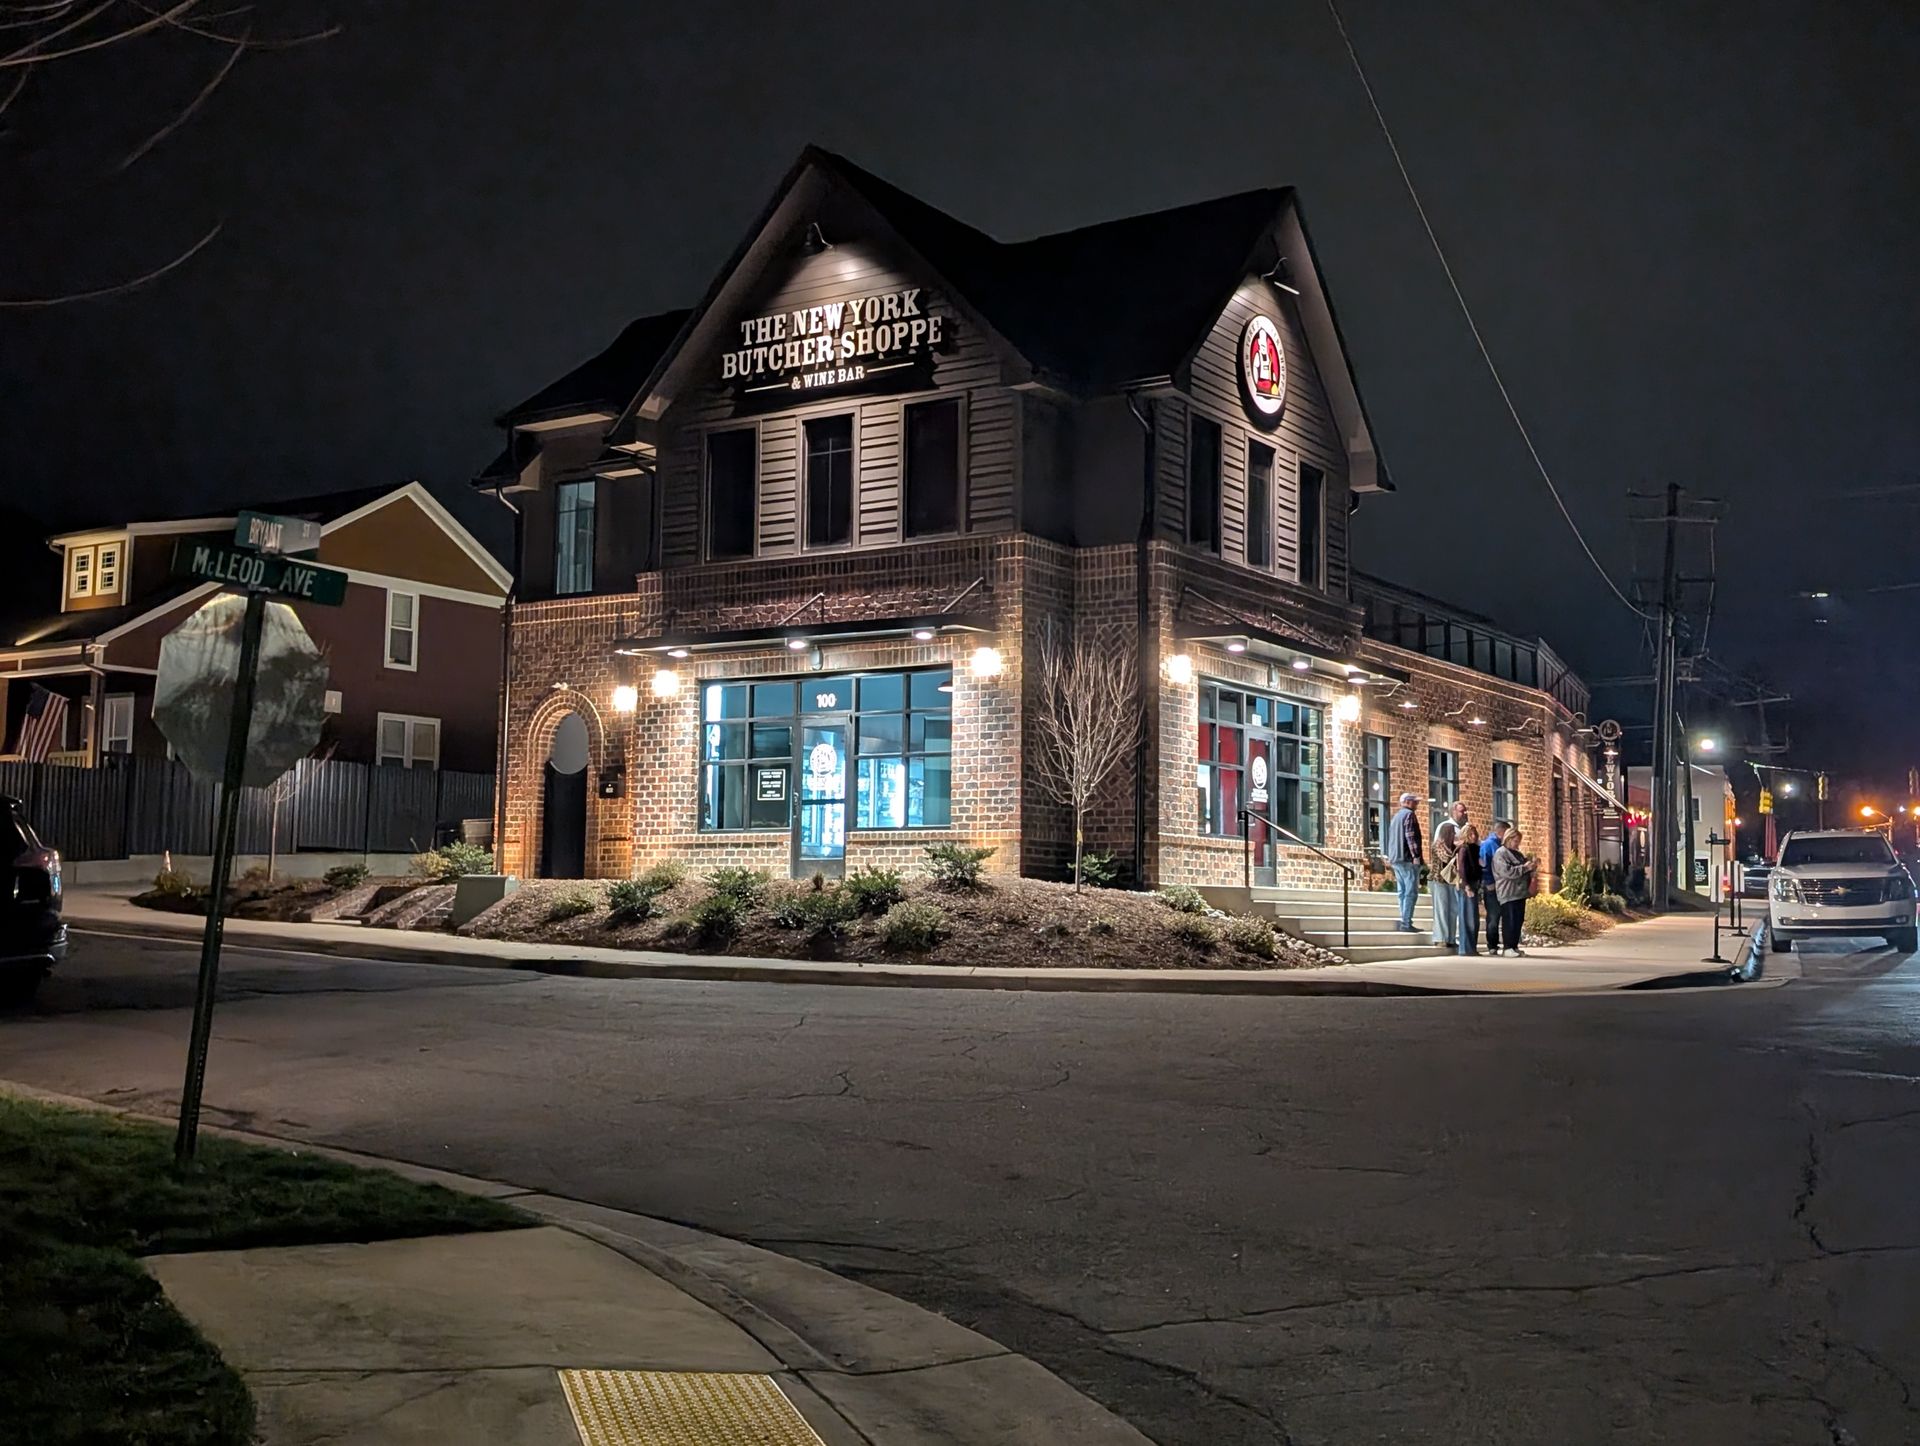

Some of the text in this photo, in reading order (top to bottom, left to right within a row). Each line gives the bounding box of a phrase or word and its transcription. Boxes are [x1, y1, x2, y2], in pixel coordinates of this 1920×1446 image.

[741, 288, 921, 346] THE NEW YORK
[722, 315, 942, 380] BUTCHER SHOPPE
[791, 365, 865, 390] & WINE BAR
[248, 517, 312, 551] BRYANT ST
[191, 546, 317, 597] McLEOD AVE
[816, 693, 836, 709] 100
